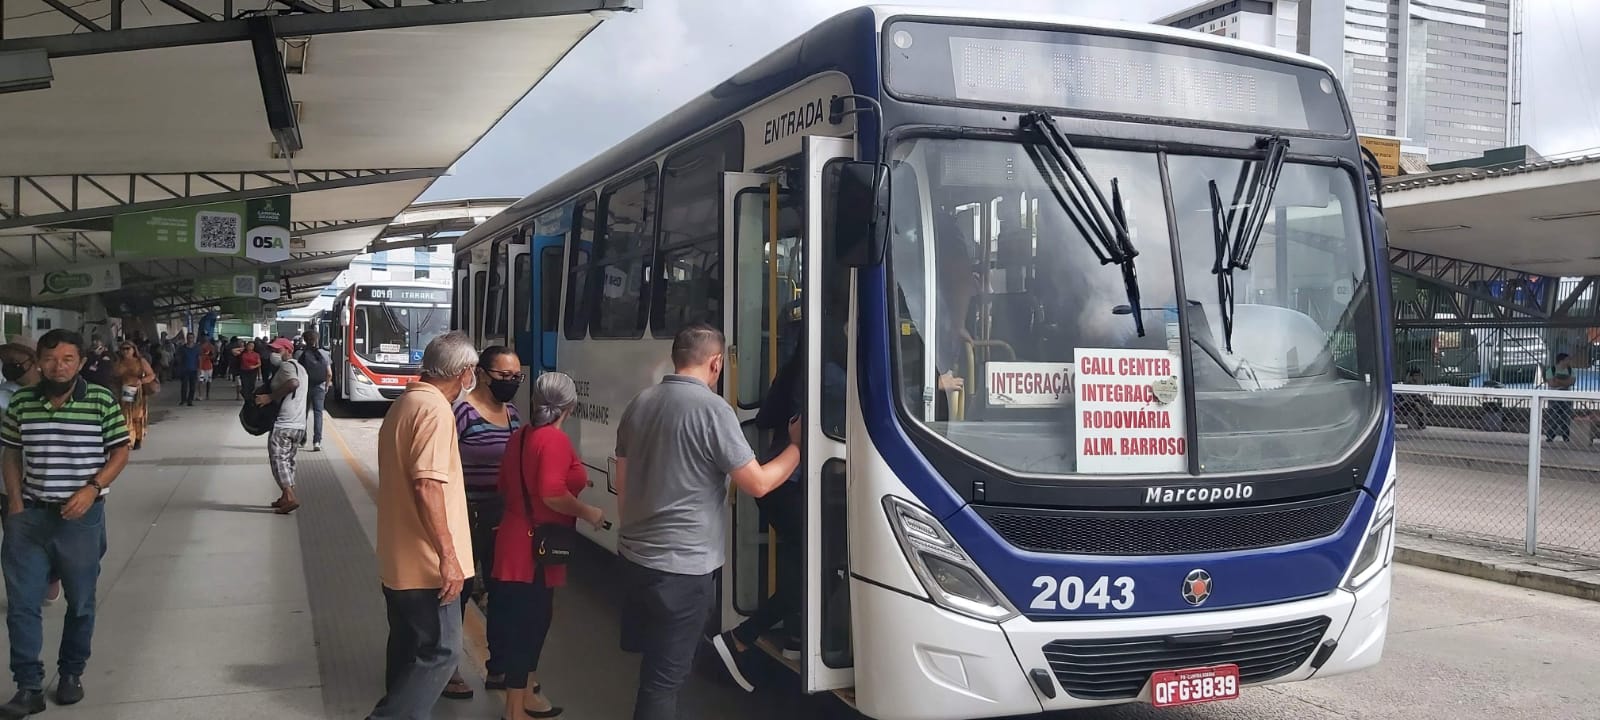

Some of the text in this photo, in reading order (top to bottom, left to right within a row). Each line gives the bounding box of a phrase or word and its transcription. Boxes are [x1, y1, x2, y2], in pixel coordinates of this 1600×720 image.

[764, 98, 824, 145] ENTRADA
[252, 235, 284, 249] 05A
[1080, 356, 1171, 376] CALL CENTER
[1081, 383, 1157, 406] INTEGRAÇ
[1082, 407, 1171, 429] RODOVIÁRIA
[1083, 437, 1186, 456] ALM. BARROSO
[1145, 484, 1253, 503] Marcopolo
[1029, 575, 1135, 610] 2043
